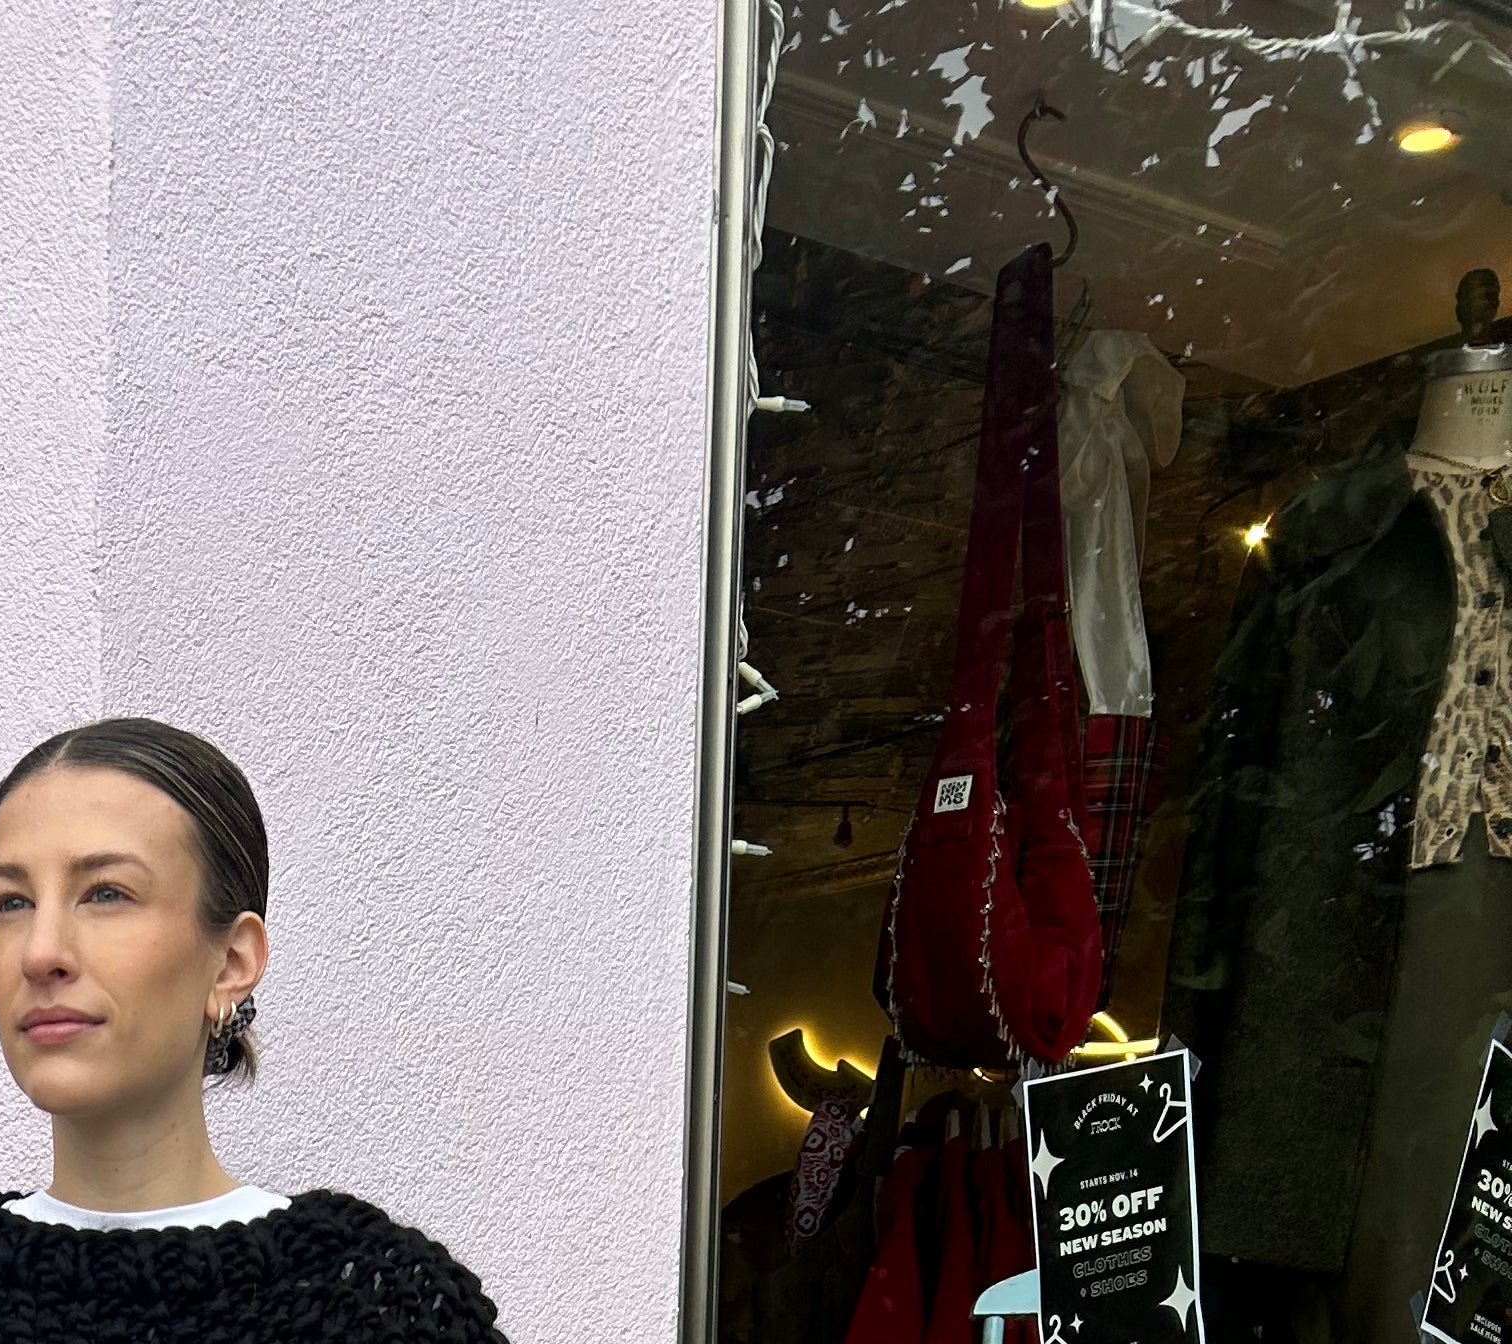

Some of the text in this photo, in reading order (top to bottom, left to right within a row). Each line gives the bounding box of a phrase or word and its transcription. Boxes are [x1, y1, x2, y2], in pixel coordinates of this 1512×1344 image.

[1073, 1093, 1139, 1130] BLACK FRIDAY AT
[1090, 1116, 1122, 1135] FROCK
[1080, 1168, 1139, 1190] STARTS NOV. 14
[1059, 1185, 1163, 1231] 30% OFF
[1471, 1195, 1503, 1223] NEW
[1059, 1217, 1167, 1257] NEW SEASON
[1072, 1246, 1152, 1279] CLOTHES
[1090, 1269, 1148, 1298] SHOES
